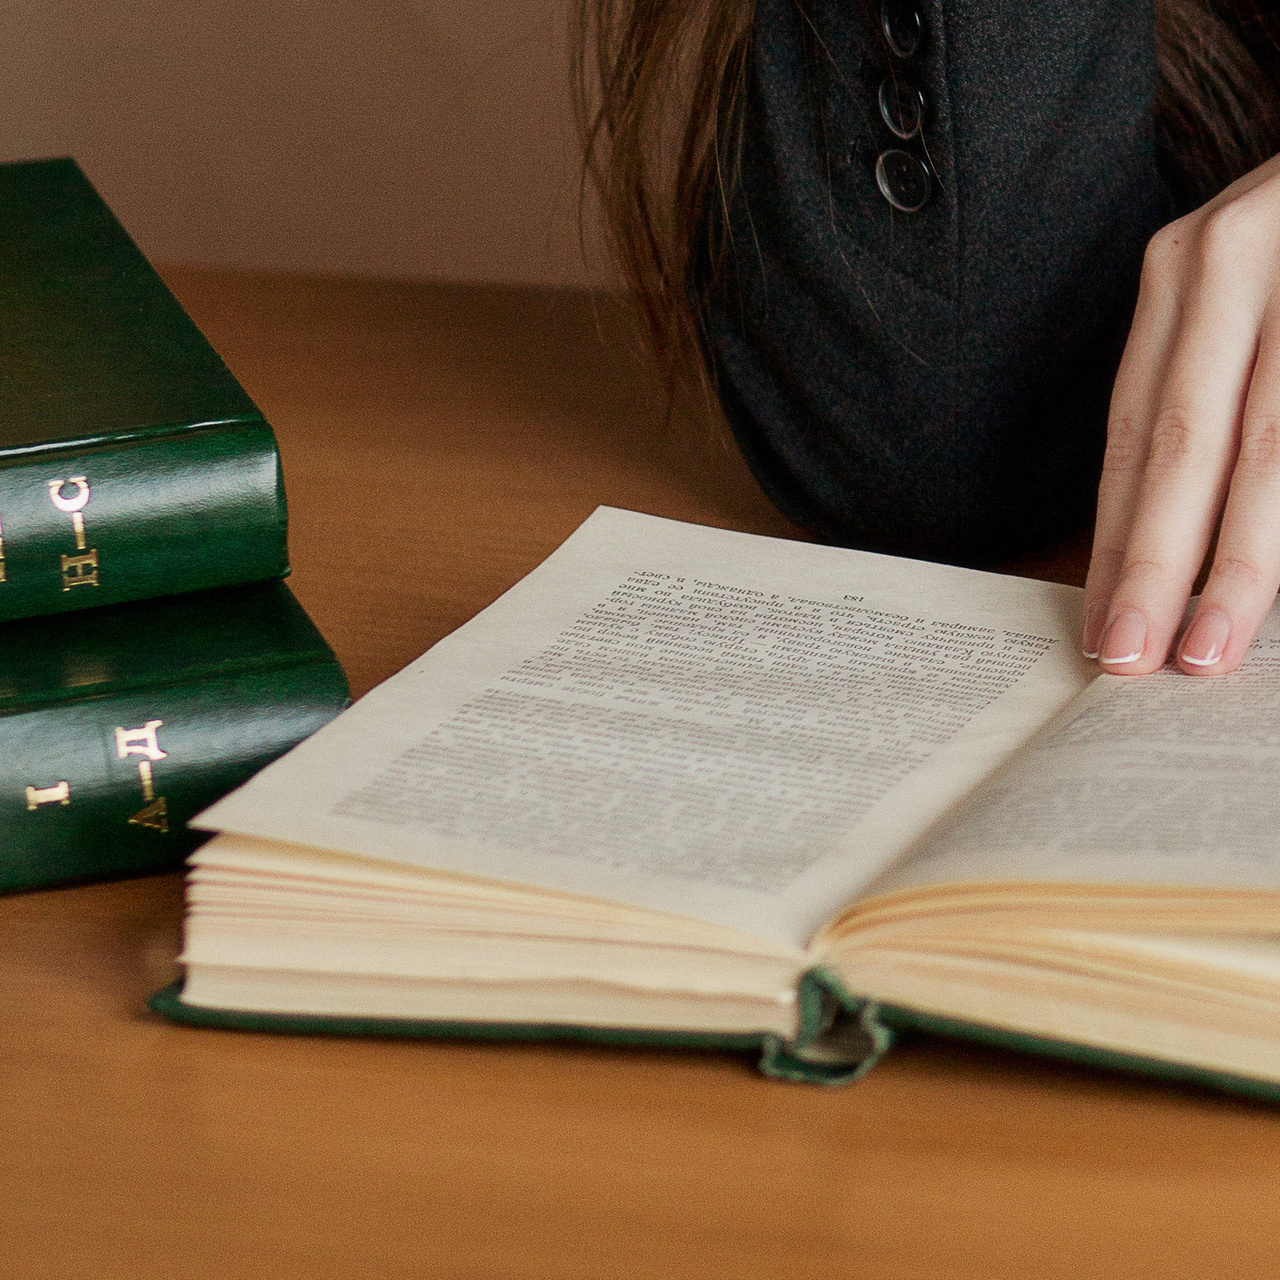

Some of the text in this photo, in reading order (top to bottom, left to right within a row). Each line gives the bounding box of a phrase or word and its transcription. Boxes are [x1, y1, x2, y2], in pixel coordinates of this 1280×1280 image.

[626, 576, 661, 586] едва
[633, 570, 671, 579] свет-
[691, 578, 766, 596] однажды,
[609, 589, 683, 606] курносый
[678, 593, 758, 611] возбудила
[692, 588, 784, 607] присутствии
[687, 603, 723, 613] свой
[765, 606, 822, 619] платок,
[784, 595, 910, 621] безмолвствовал,
[829, 610, 855, 618] что
[753, 612, 824, 626] несмотря
[863, 615, 926, 630] страсть,
[931, 619, 996, 633] замирал
[828, 623, 895, 640] которая,
[846, 620, 913, 636] смеяться
[933, 628, 995, 640] нежную
[920, 633, 995, 648] привычку
[999, 630, 1058, 643] дышал,
[1003, 637, 1051, 649] такую
[898, 637, 975, 654] Клавдию,
[980, 649, 1038, 663] ничную
